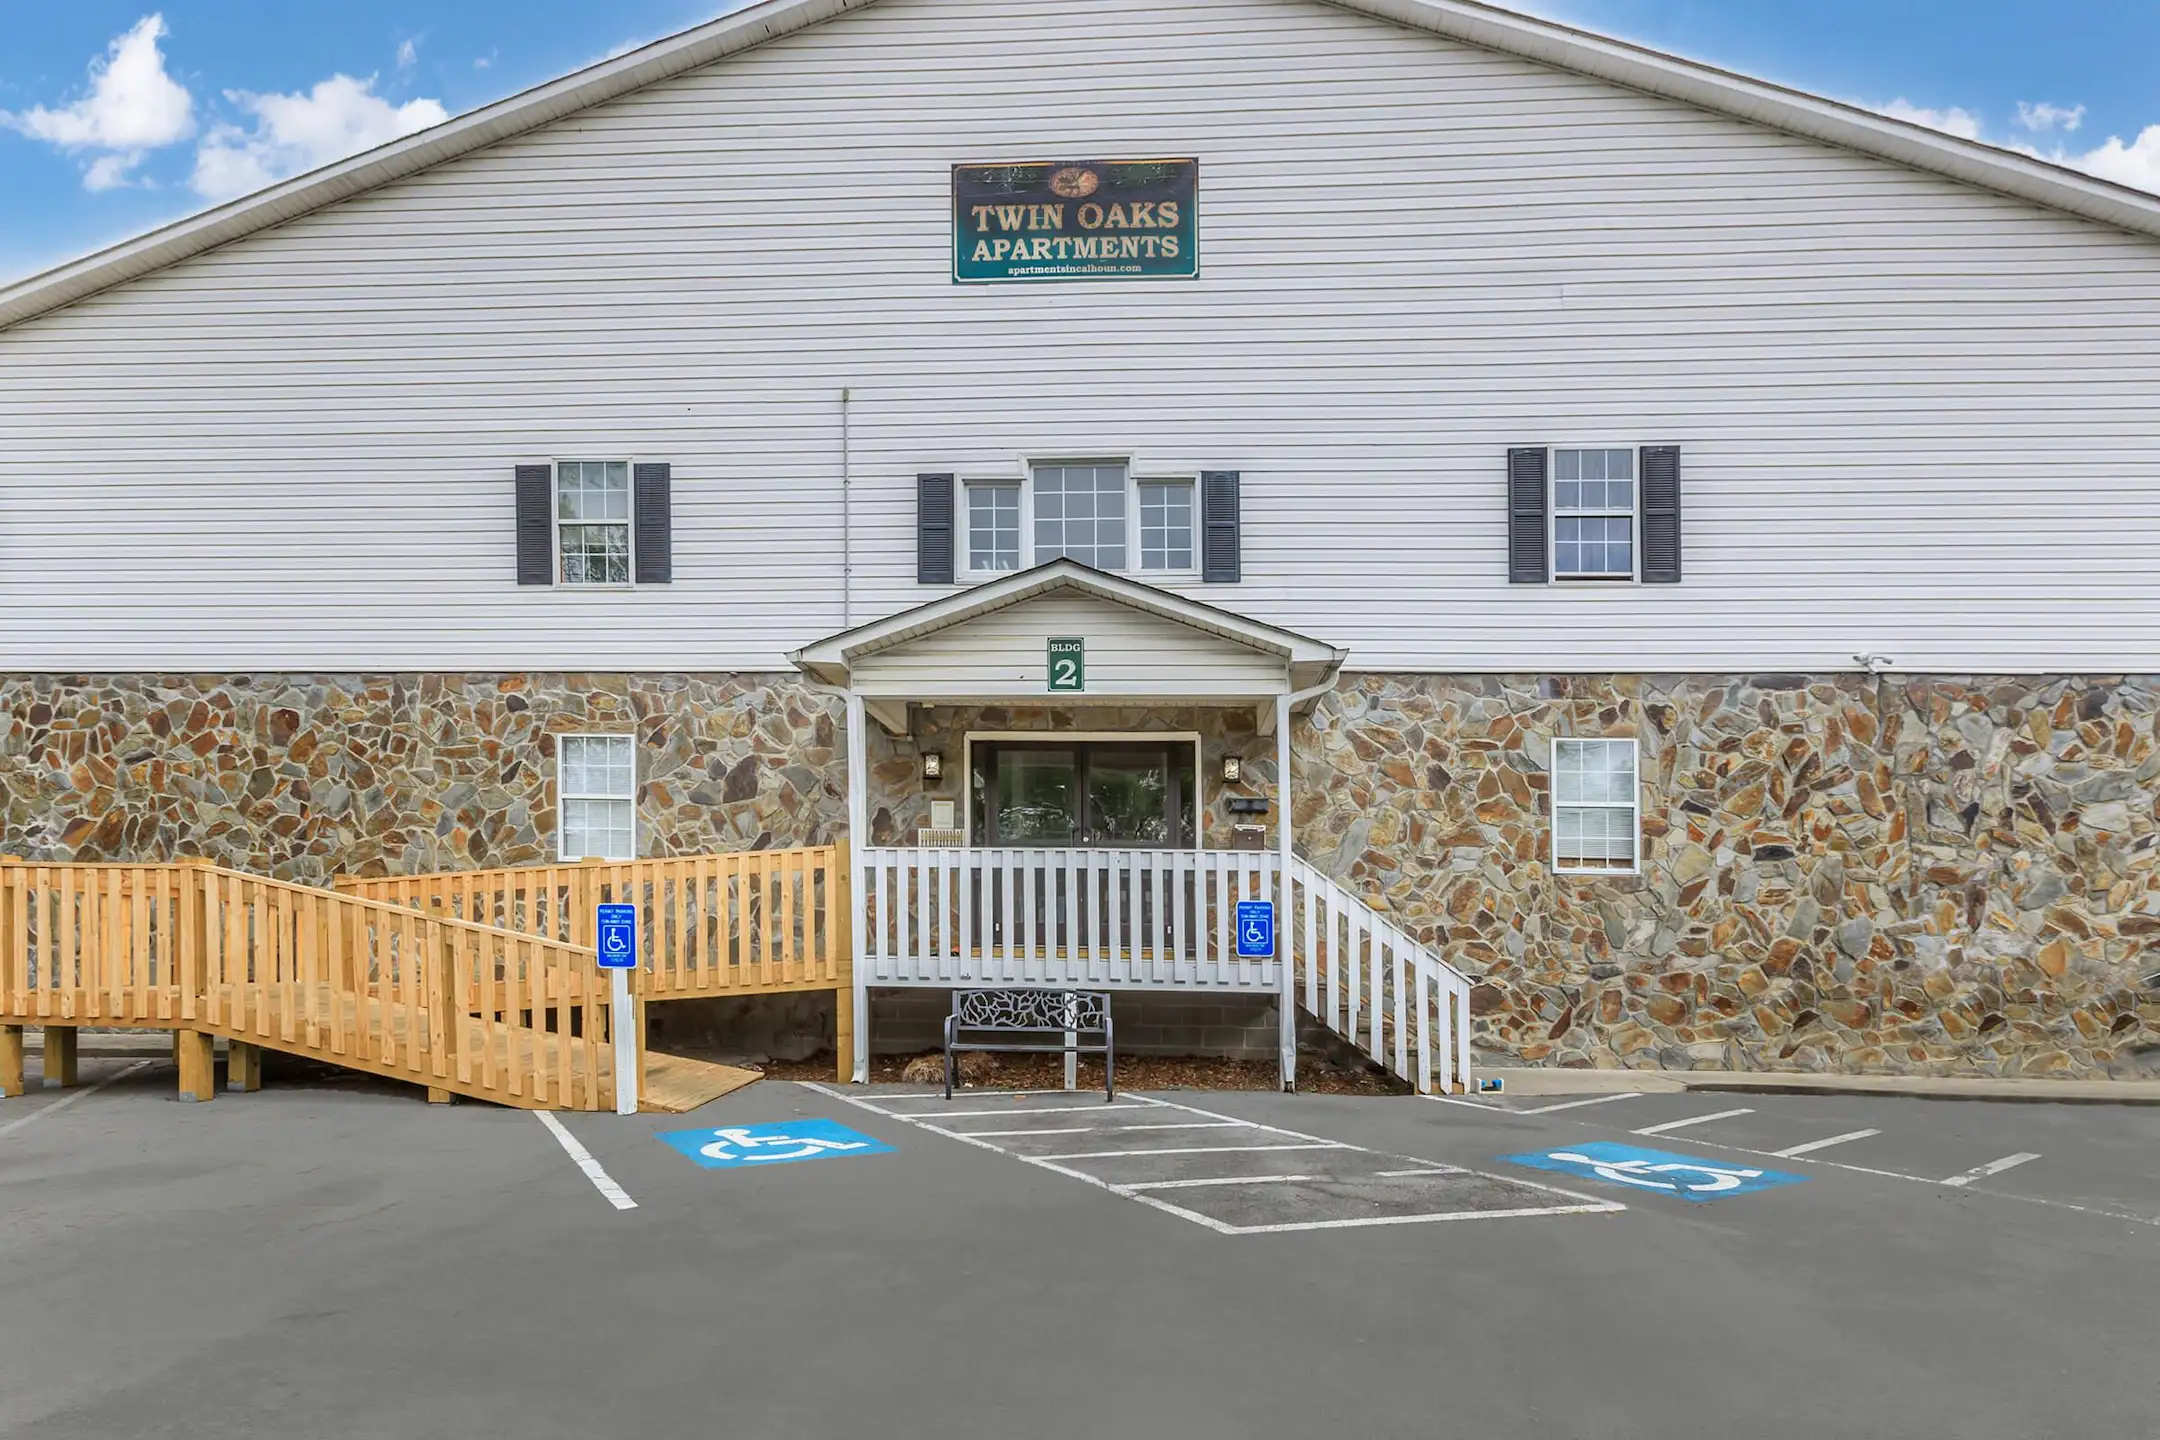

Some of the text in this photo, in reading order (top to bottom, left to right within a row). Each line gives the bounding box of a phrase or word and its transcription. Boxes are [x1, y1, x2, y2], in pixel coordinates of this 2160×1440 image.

[971, 201, 1180, 232] TWIN OAKS
[971, 235, 1180, 261] APARTMENTS
[1008, 264, 1142, 275] apartmentsincalhoun.com
[1051, 643, 1081, 652] BLDG
[1055, 659, 1077, 686] 2
